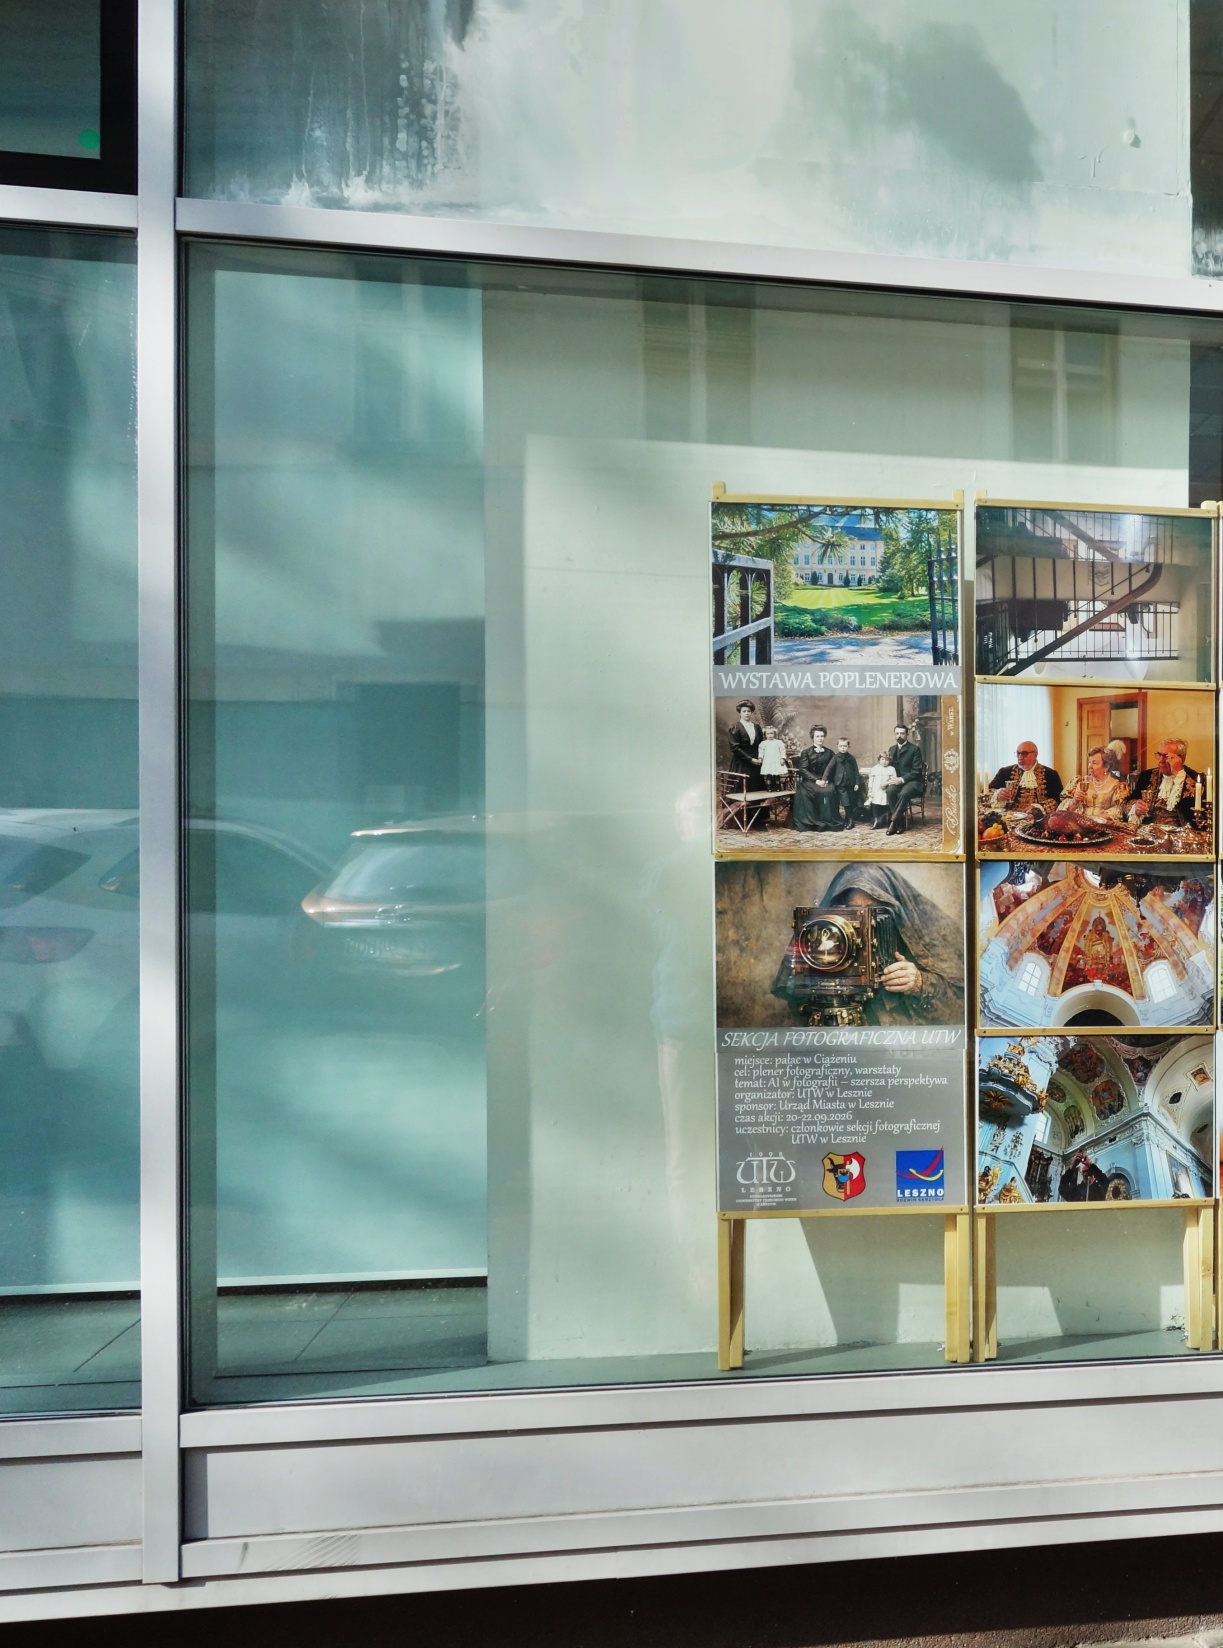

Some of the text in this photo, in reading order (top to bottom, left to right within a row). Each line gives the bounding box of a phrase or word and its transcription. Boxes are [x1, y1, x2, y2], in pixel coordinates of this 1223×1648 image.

[718, 671, 958, 689] WYSTAWA POPLENEROWA
[721, 1029, 962, 1051] SEKCJA FOTOGRAFICZNA UTW
[734, 1055, 773, 1067] miejsce:
[775, 1053, 801, 1067] pałac
[813, 1053, 857, 1066] Ciążeniu
[734, 1064, 902, 1079] cel: plener fotograficzny, warsztaty
[734, 1077, 766, 1088] temat:
[768, 1077, 780, 1087] AI
[790, 1076, 838, 1090] fotografii
[850, 1078, 886, 1086] szersza
[887, 1074, 948, 1088] perspektywa
[734, 1088, 795, 1102] organizator:
[797, 1088, 824, 1099] UTW
[837, 1088, 873, 1098] Lesznie
[734, 1102, 777, 1114] sponsor:
[779, 1100, 811, 1112] Urząd
[812, 1099, 846, 1110] Miasta
[858, 1099, 894, 1109] Lesznie
[734, 1111, 853, 1125] czas akcji: 20-22.09.2026
[735, 1119, 941, 1136] uczestnicy: członkowie sekcji fotograficznej
[791, 1134, 818, 1144] UTW
[830, 1133, 867, 1143] Lesznie
[740, 1186, 792, 1194] LESZNO
[897, 1188, 944, 1197] LESZNO
